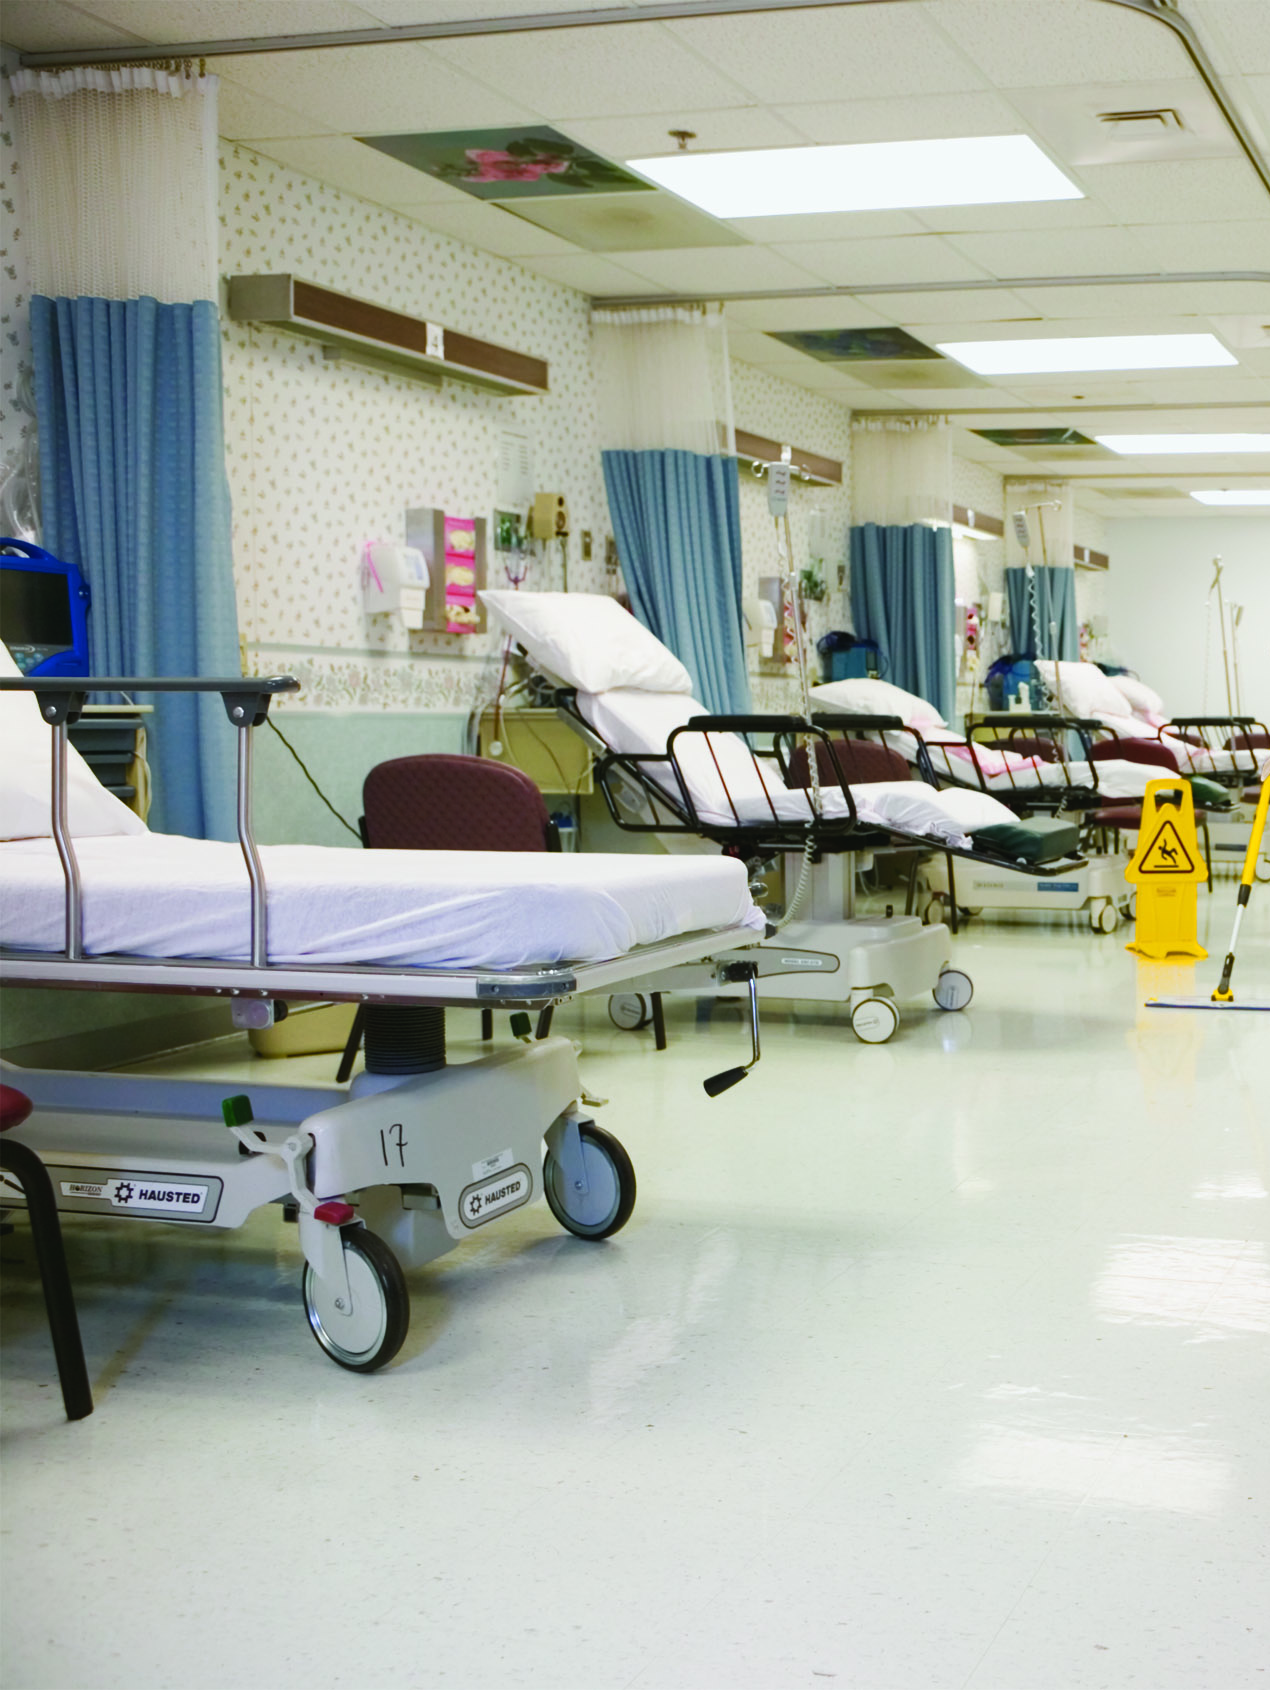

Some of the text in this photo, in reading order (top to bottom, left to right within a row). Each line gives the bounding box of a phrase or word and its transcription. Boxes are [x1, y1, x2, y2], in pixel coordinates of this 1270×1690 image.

[379, 1123, 409, 1168] 17
[138, 1189, 201, 1204] HAUSTED
[485, 1181, 521, 1206] HAUSTED
